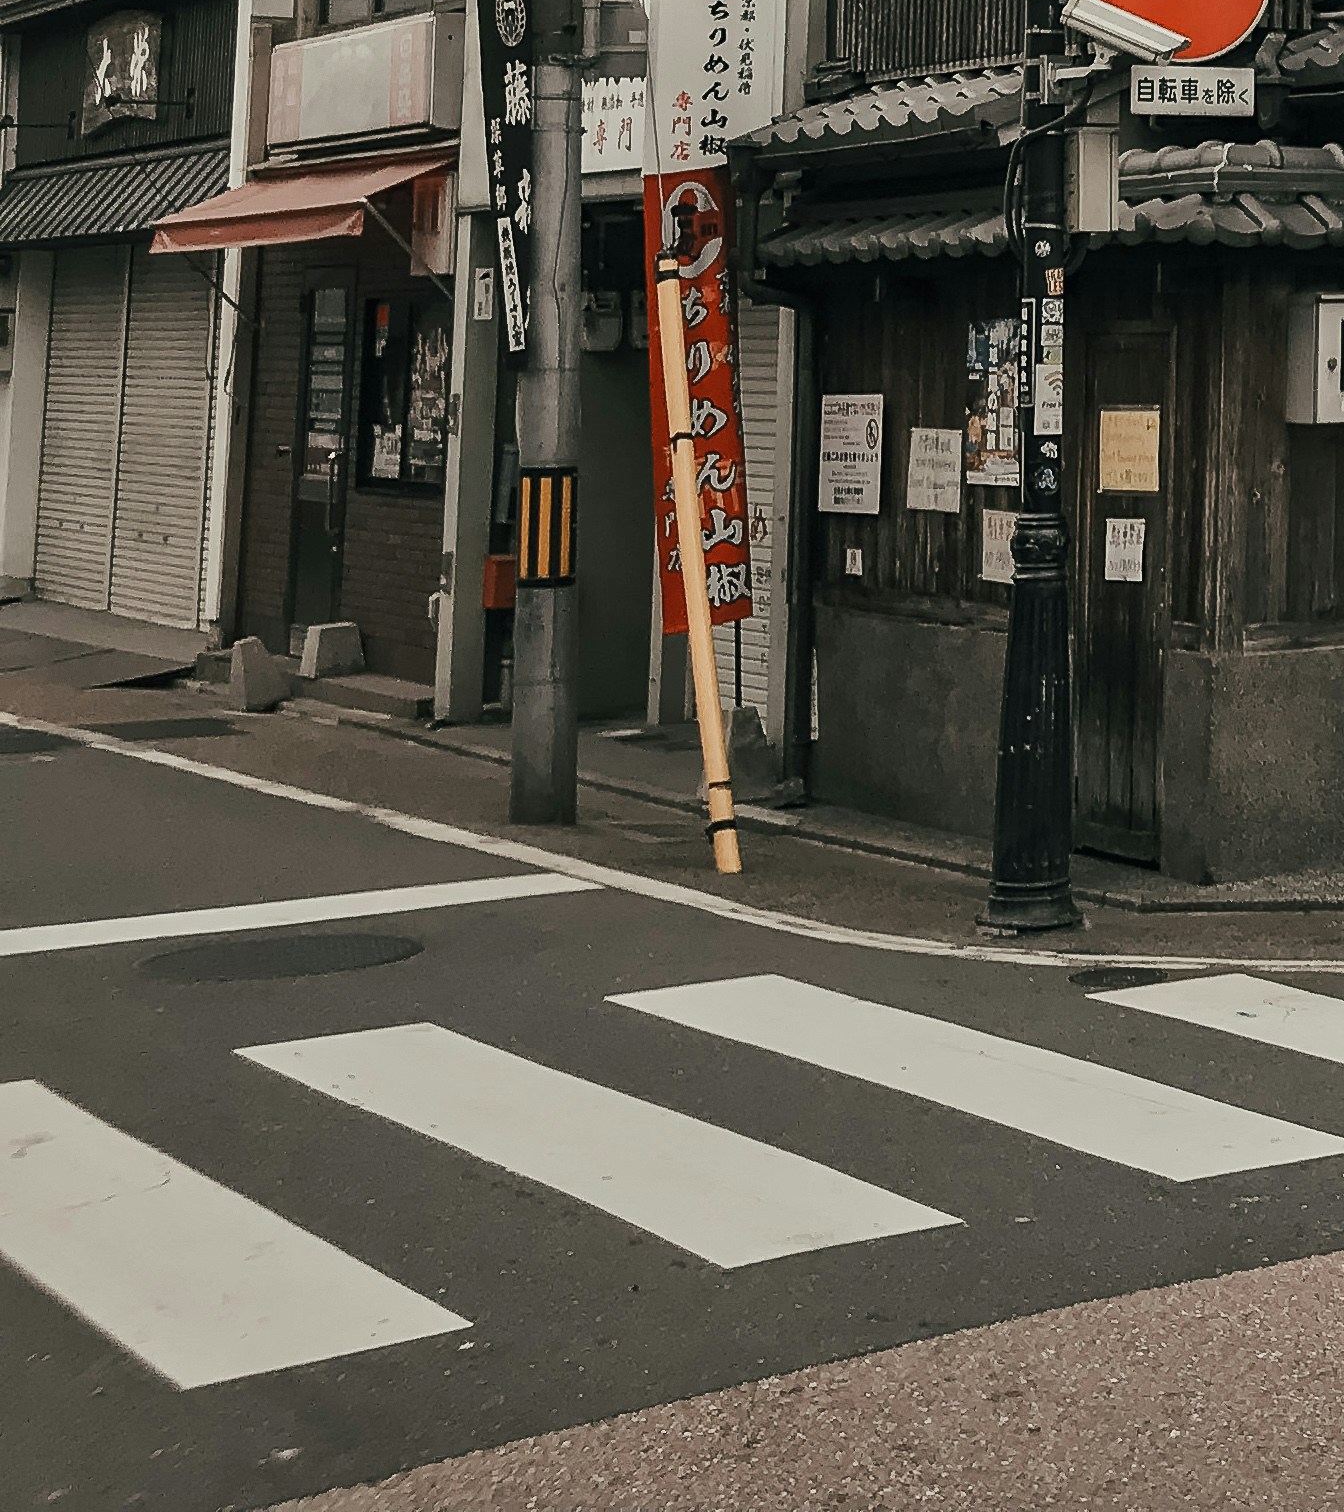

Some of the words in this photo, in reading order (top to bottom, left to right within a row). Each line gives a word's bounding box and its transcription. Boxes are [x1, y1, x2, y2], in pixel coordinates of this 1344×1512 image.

[670, 90, 693, 161] 専門店
[699, 0, 730, 156] ちりめん山椒
[1137, 76, 1249, 105] 自転車を除く
[682, 286, 751, 607] ちりめん山椒
